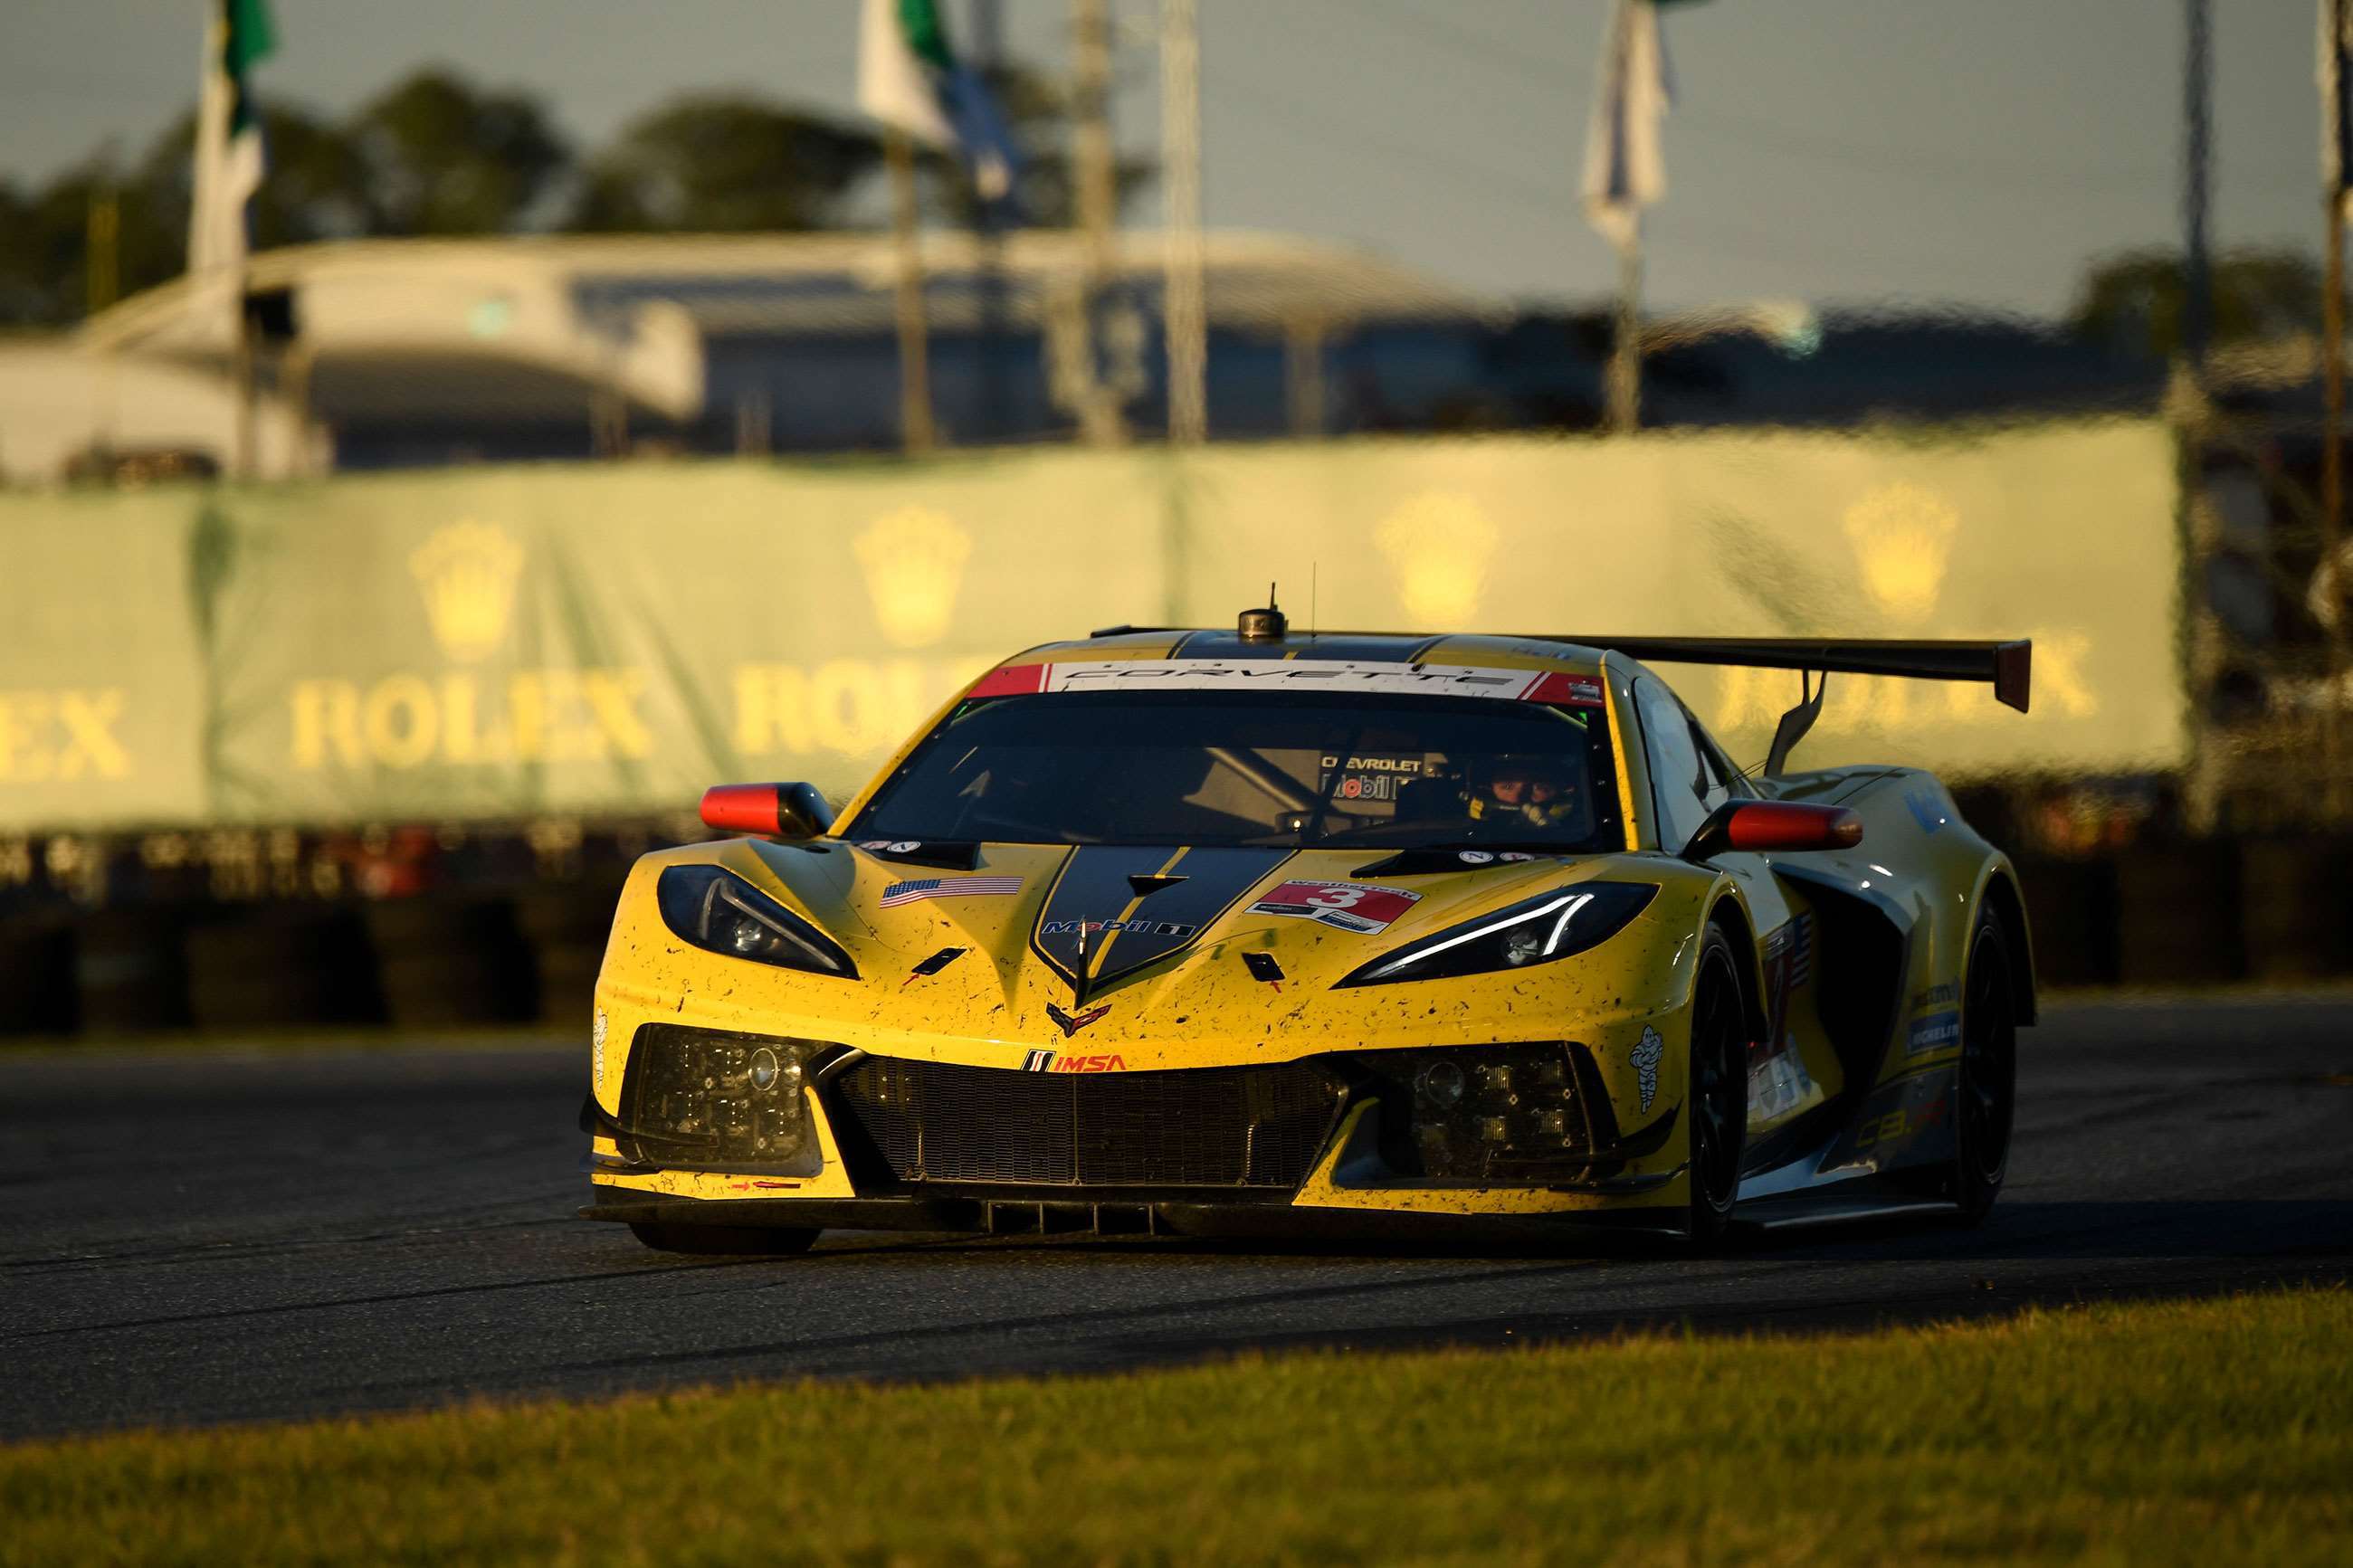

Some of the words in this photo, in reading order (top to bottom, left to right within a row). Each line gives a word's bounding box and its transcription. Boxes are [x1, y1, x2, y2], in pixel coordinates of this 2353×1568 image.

[1065, 669, 1515, 686] CORVETTE
[290, 668, 659, 769] ROLEX
[1320, 755, 1423, 773] CEVROLET
[1305, 887, 1367, 908] 3
[1042, 917, 1152, 935] Mobil
[1053, 1054, 1127, 1072] IMSA
